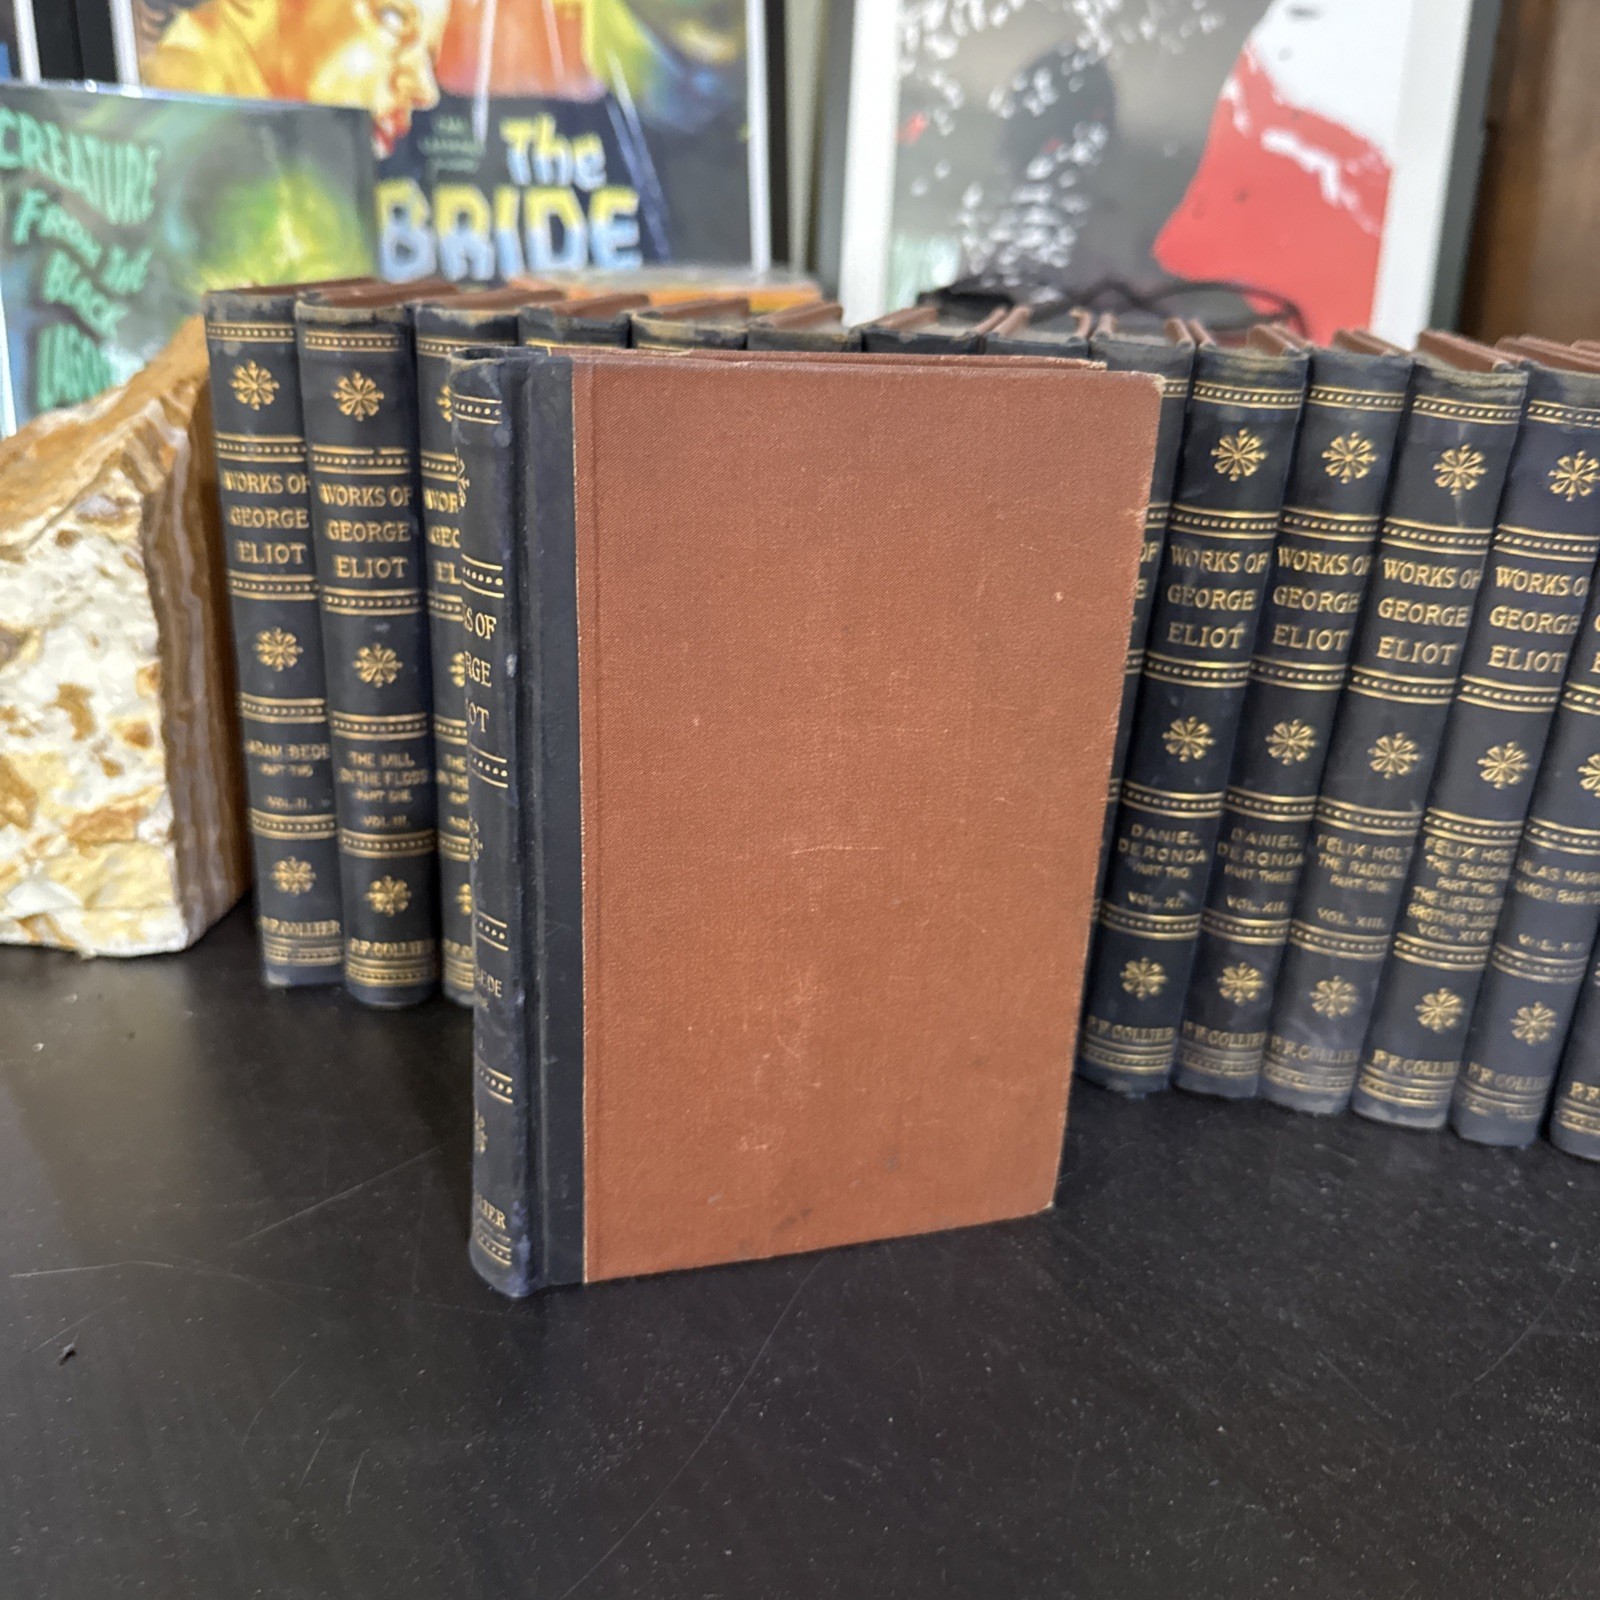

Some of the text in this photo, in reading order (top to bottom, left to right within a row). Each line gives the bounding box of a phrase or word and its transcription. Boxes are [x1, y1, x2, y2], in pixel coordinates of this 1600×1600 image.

[501, 113, 606, 192] The
[373, 178, 643, 284] BRIDE
[223, 470, 283, 495] WORKS
[318, 483, 412, 508] WORKS OF
[424, 488, 459, 513] WOR
[229, 506, 309, 529] GEORGE
[326, 519, 412, 543] GEORGE
[236, 540, 308, 565] ELIOT
[335, 554, 409, 578] ELIOT
[1170, 544, 1270, 574] WORKS OF
[1277, 546, 1349, 576] WORKS
[1383, 557, 1458, 589] WORKS
[1495, 565, 1571, 596] WORKS
[1167, 583, 1258, 611] GEORGE
[1273, 585, 1361, 614] GEORGE
[475, 611, 497, 639] OF
[1378, 596, 1469, 628] GEORGE
[1489, 605, 1580, 635] GEORGE
[1167, 622, 1246, 649] ELIOT
[1271, 623, 1350, 651] ELIOT
[1376, 635, 1458, 665] ELIOT
[1487, 644, 1568, 673] ELIOT
[348, 751, 376, 769] THE
[1131, 823, 1200, 846] DANIEL
[1231, 826, 1300, 849] DANIEL
